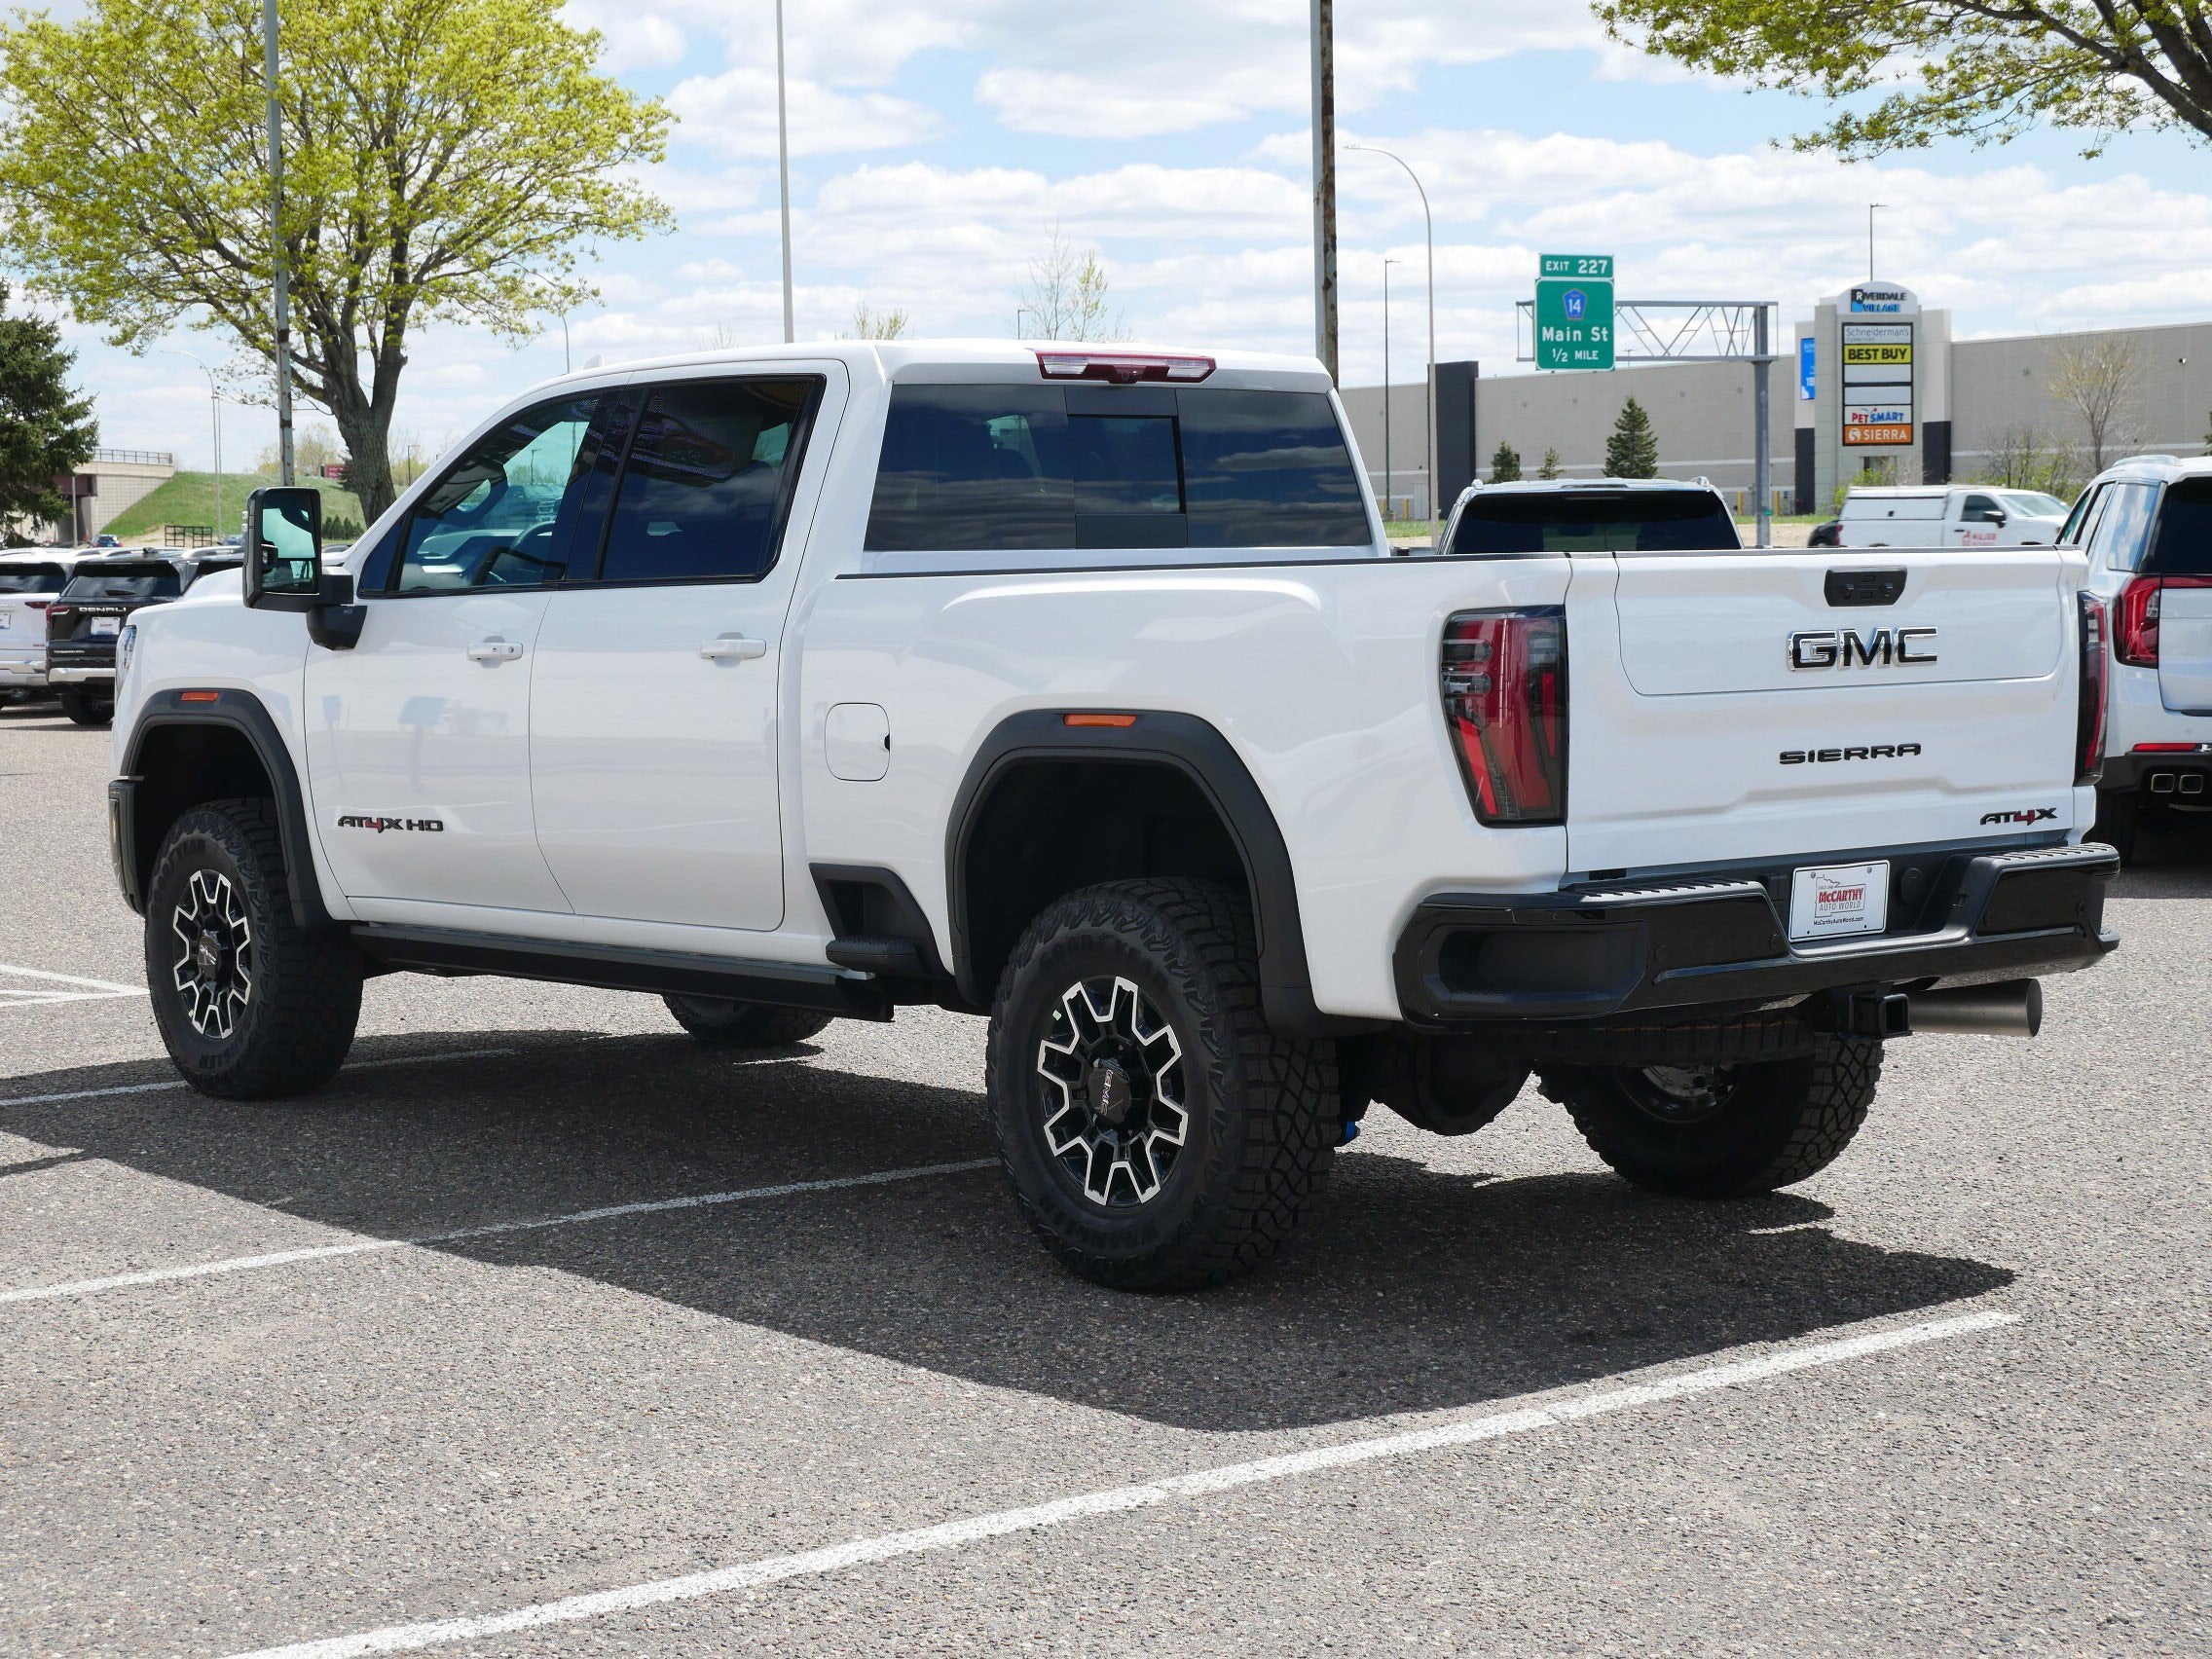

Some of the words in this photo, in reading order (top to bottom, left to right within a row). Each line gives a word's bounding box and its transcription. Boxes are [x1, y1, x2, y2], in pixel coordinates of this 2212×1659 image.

[1545, 260, 1569, 272] EXIT
[1577, 259, 1607, 275] 227
[1568, 298, 1581, 313] 14
[1862, 303, 1901, 313] VILLAGE
[1541, 326, 1582, 342] Main
[1590, 326, 1608, 342] St
[1845, 327, 1909, 337] Schneiderman's
[1574, 350, 1599, 360] MILE
[1848, 348, 1879, 360] BEST
[1881, 348, 1907, 360] BUY
[1862, 428, 1907, 440] SIERRA
[1787, 626, 1938, 672] GMC
[1779, 742, 1922, 765] SIERRA
[337, 815, 404, 833] AT4X
[406, 819, 444, 832] HD
[1979, 807, 2059, 827] AT4X
[1819, 887, 1863, 903] McCARTHY
[1820, 903, 1836, 912] AUTO
[1838, 900, 1862, 910] WORLD
